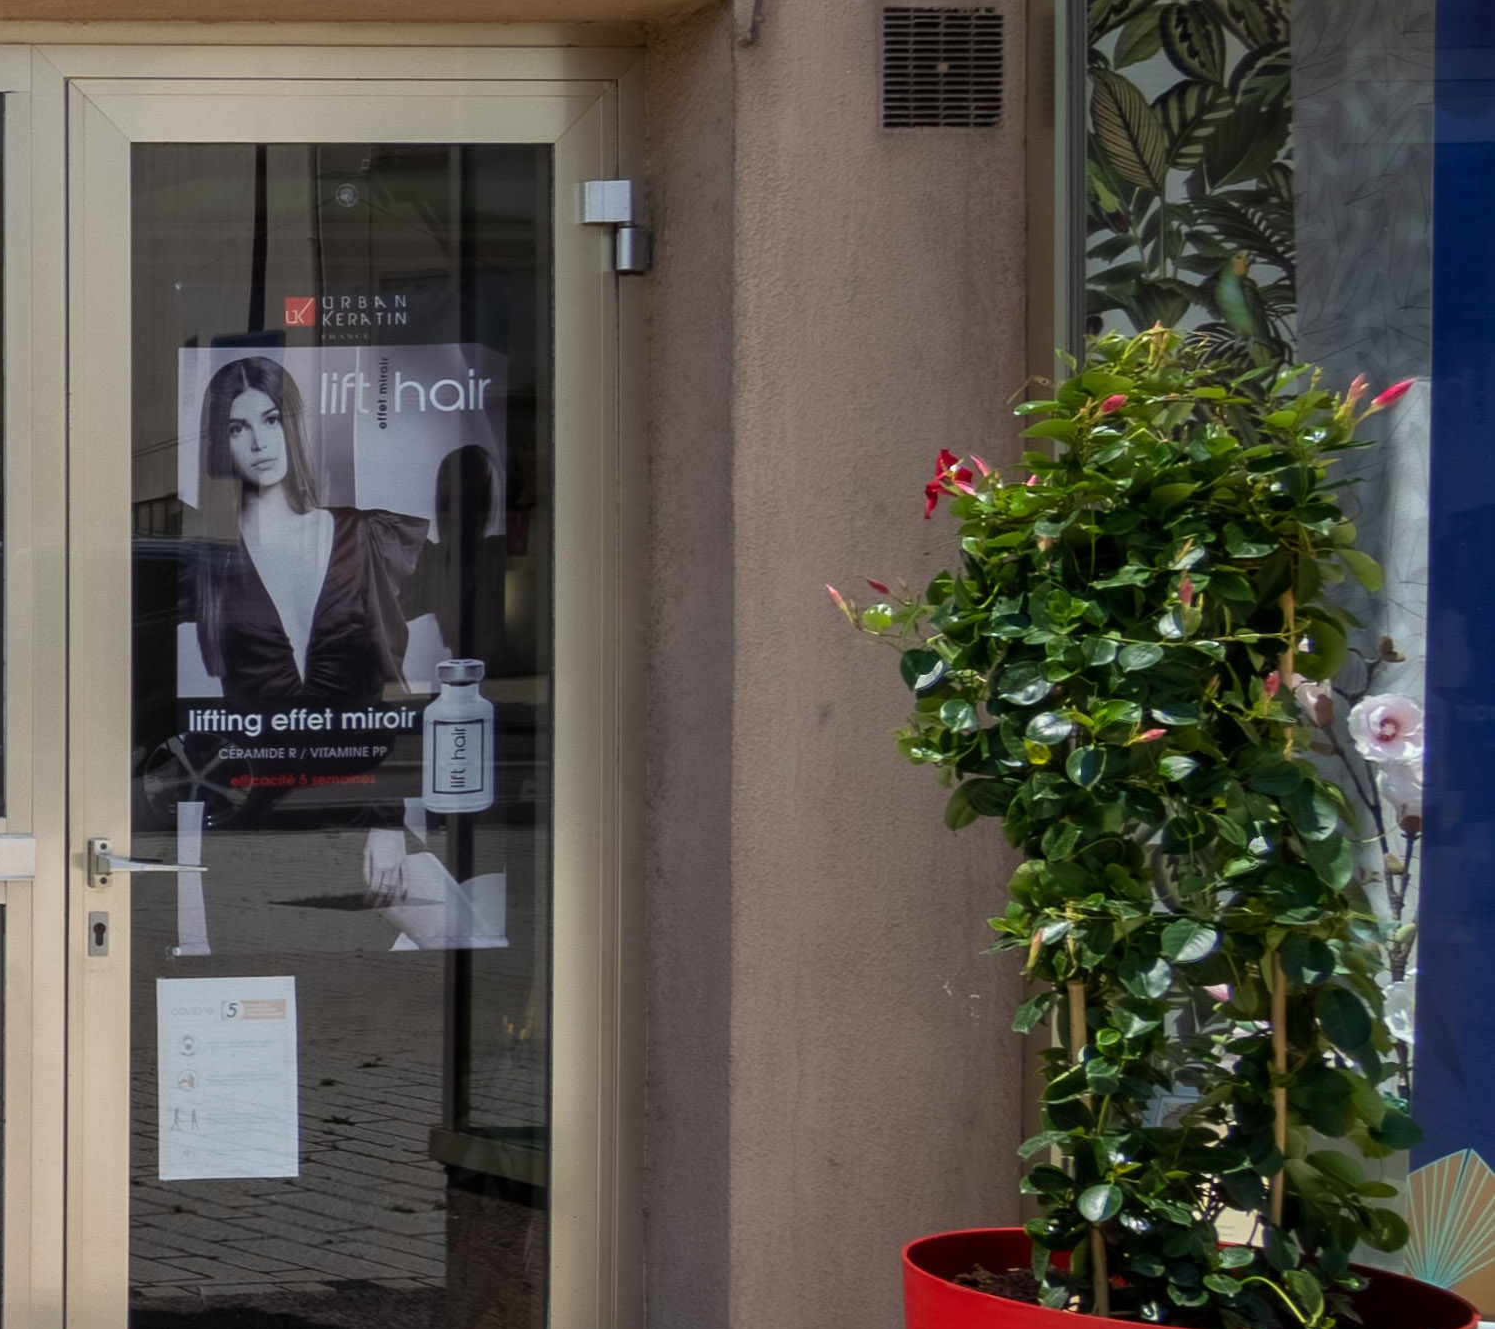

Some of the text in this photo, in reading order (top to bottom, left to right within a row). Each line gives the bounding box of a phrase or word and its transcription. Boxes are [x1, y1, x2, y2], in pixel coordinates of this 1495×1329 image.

[322, 295, 408, 310] URBAN
[322, 310, 408, 327] KERATIN
[320, 368, 492, 415] lift hair
[376, 356, 390, 430] effet miroir
[188, 706, 417, 737] lifting effet miroir
[218, 744, 286, 760] CÉRAMIDE
[288, 747, 297, 759] R
[310, 746, 369, 759] VITAMINE
[372, 745, 388, 758] PP
[450, 726, 467, 789] lift hair
[229, 772, 376, 789] efficacité 5 semaines
[225, 1002, 238, 1018] 5
